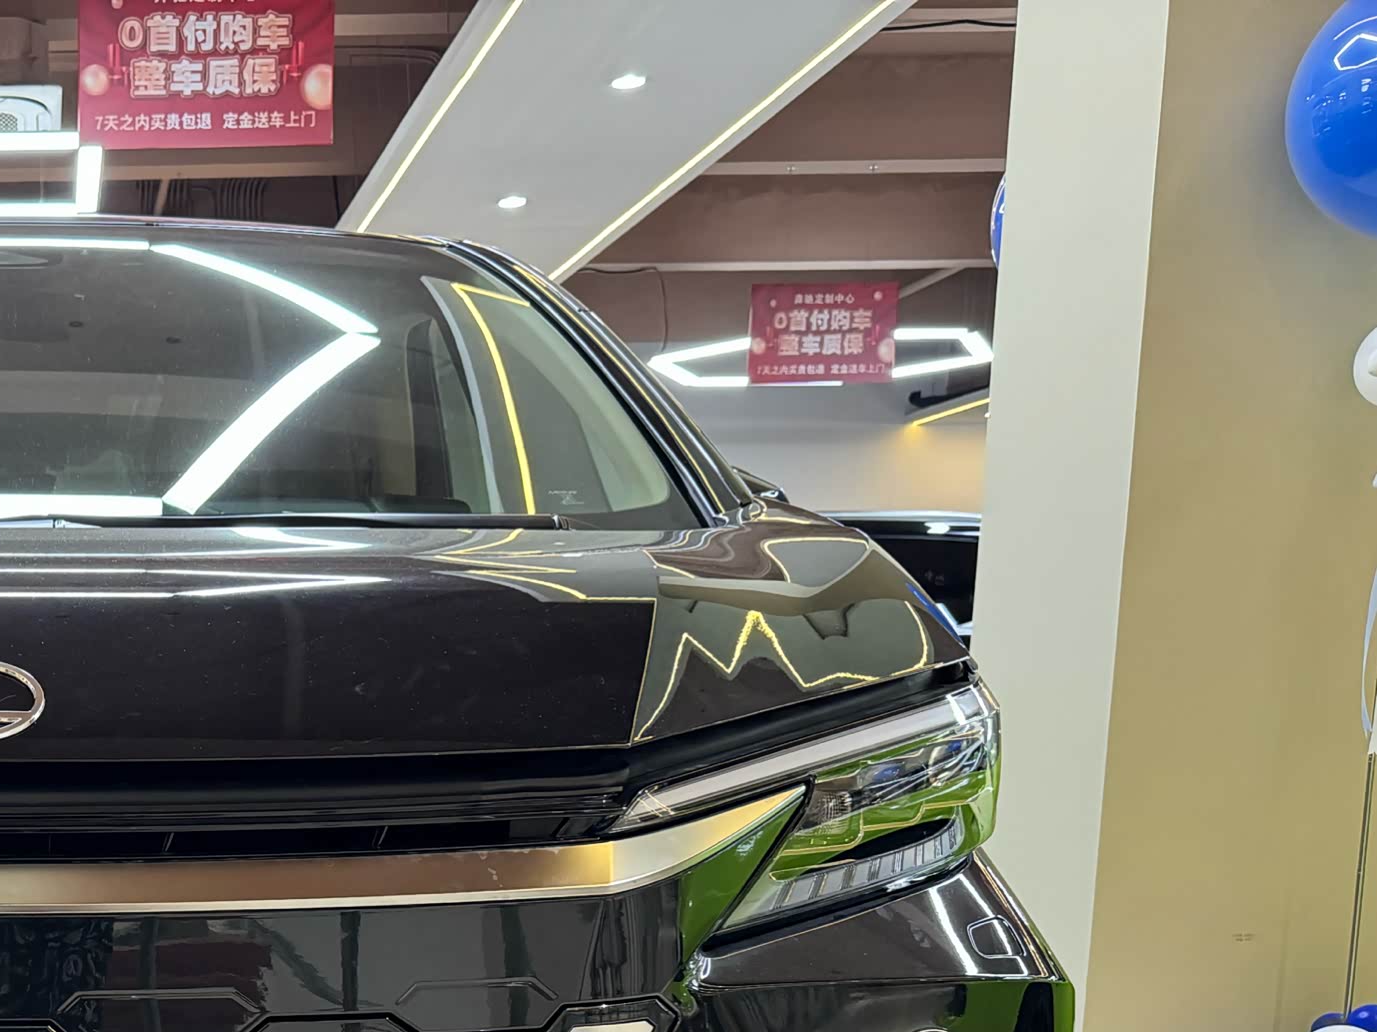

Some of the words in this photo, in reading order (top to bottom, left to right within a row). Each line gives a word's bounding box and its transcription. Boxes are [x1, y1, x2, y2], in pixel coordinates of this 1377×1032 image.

[119, 11, 291, 53] 0首付购车
[130, 57, 278, 98] 整车质保
[95, 113, 212, 130] 7天之内买贵包退
[223, 111, 315, 129] 定金送车上门
[774, 308, 872, 331] 0首付购车
